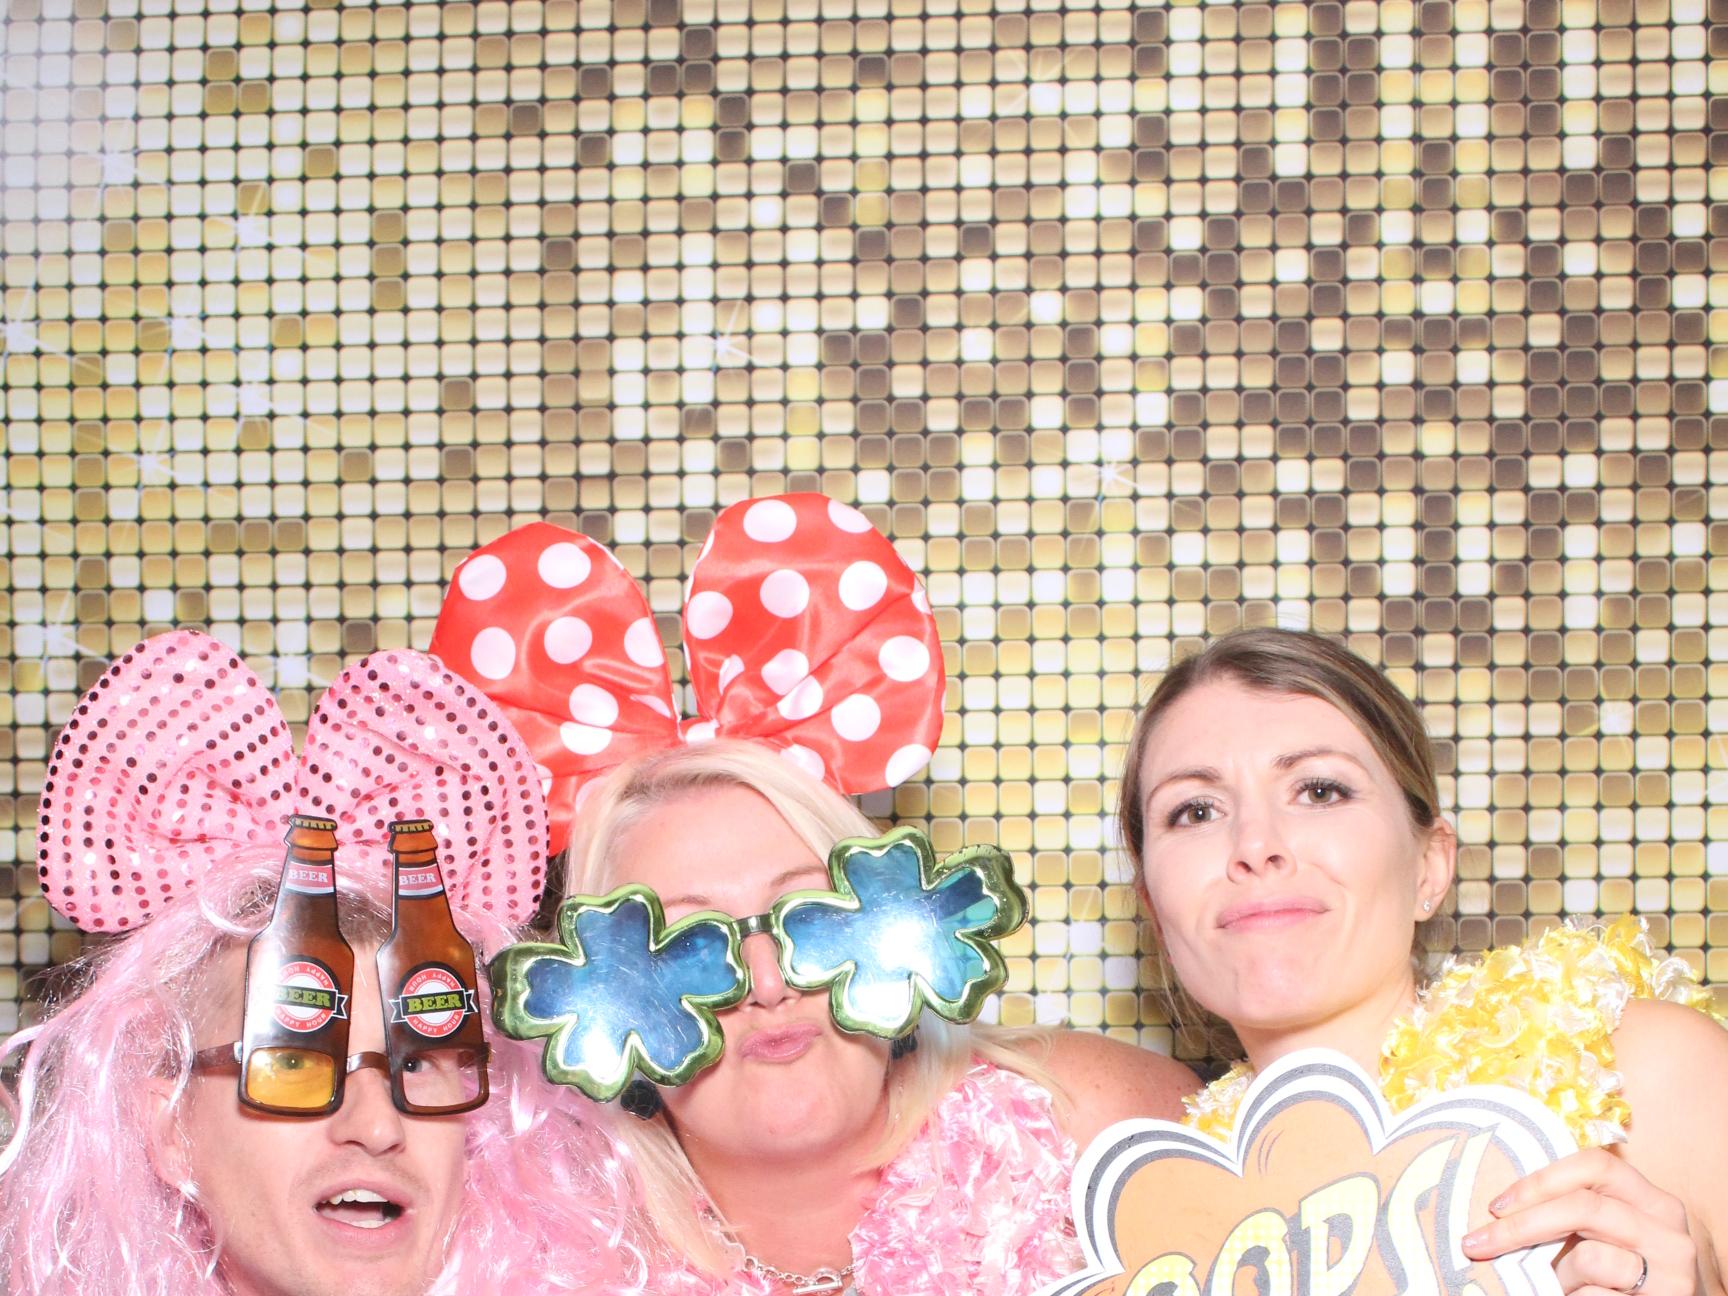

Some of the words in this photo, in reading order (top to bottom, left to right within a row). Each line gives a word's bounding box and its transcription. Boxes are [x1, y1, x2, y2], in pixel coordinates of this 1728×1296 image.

[288, 869, 329, 883] BEER
[399, 873, 436, 886] BEER
[407, 994, 462, 1013] BEER
[412, 1018, 438, 1033] HAPPY
